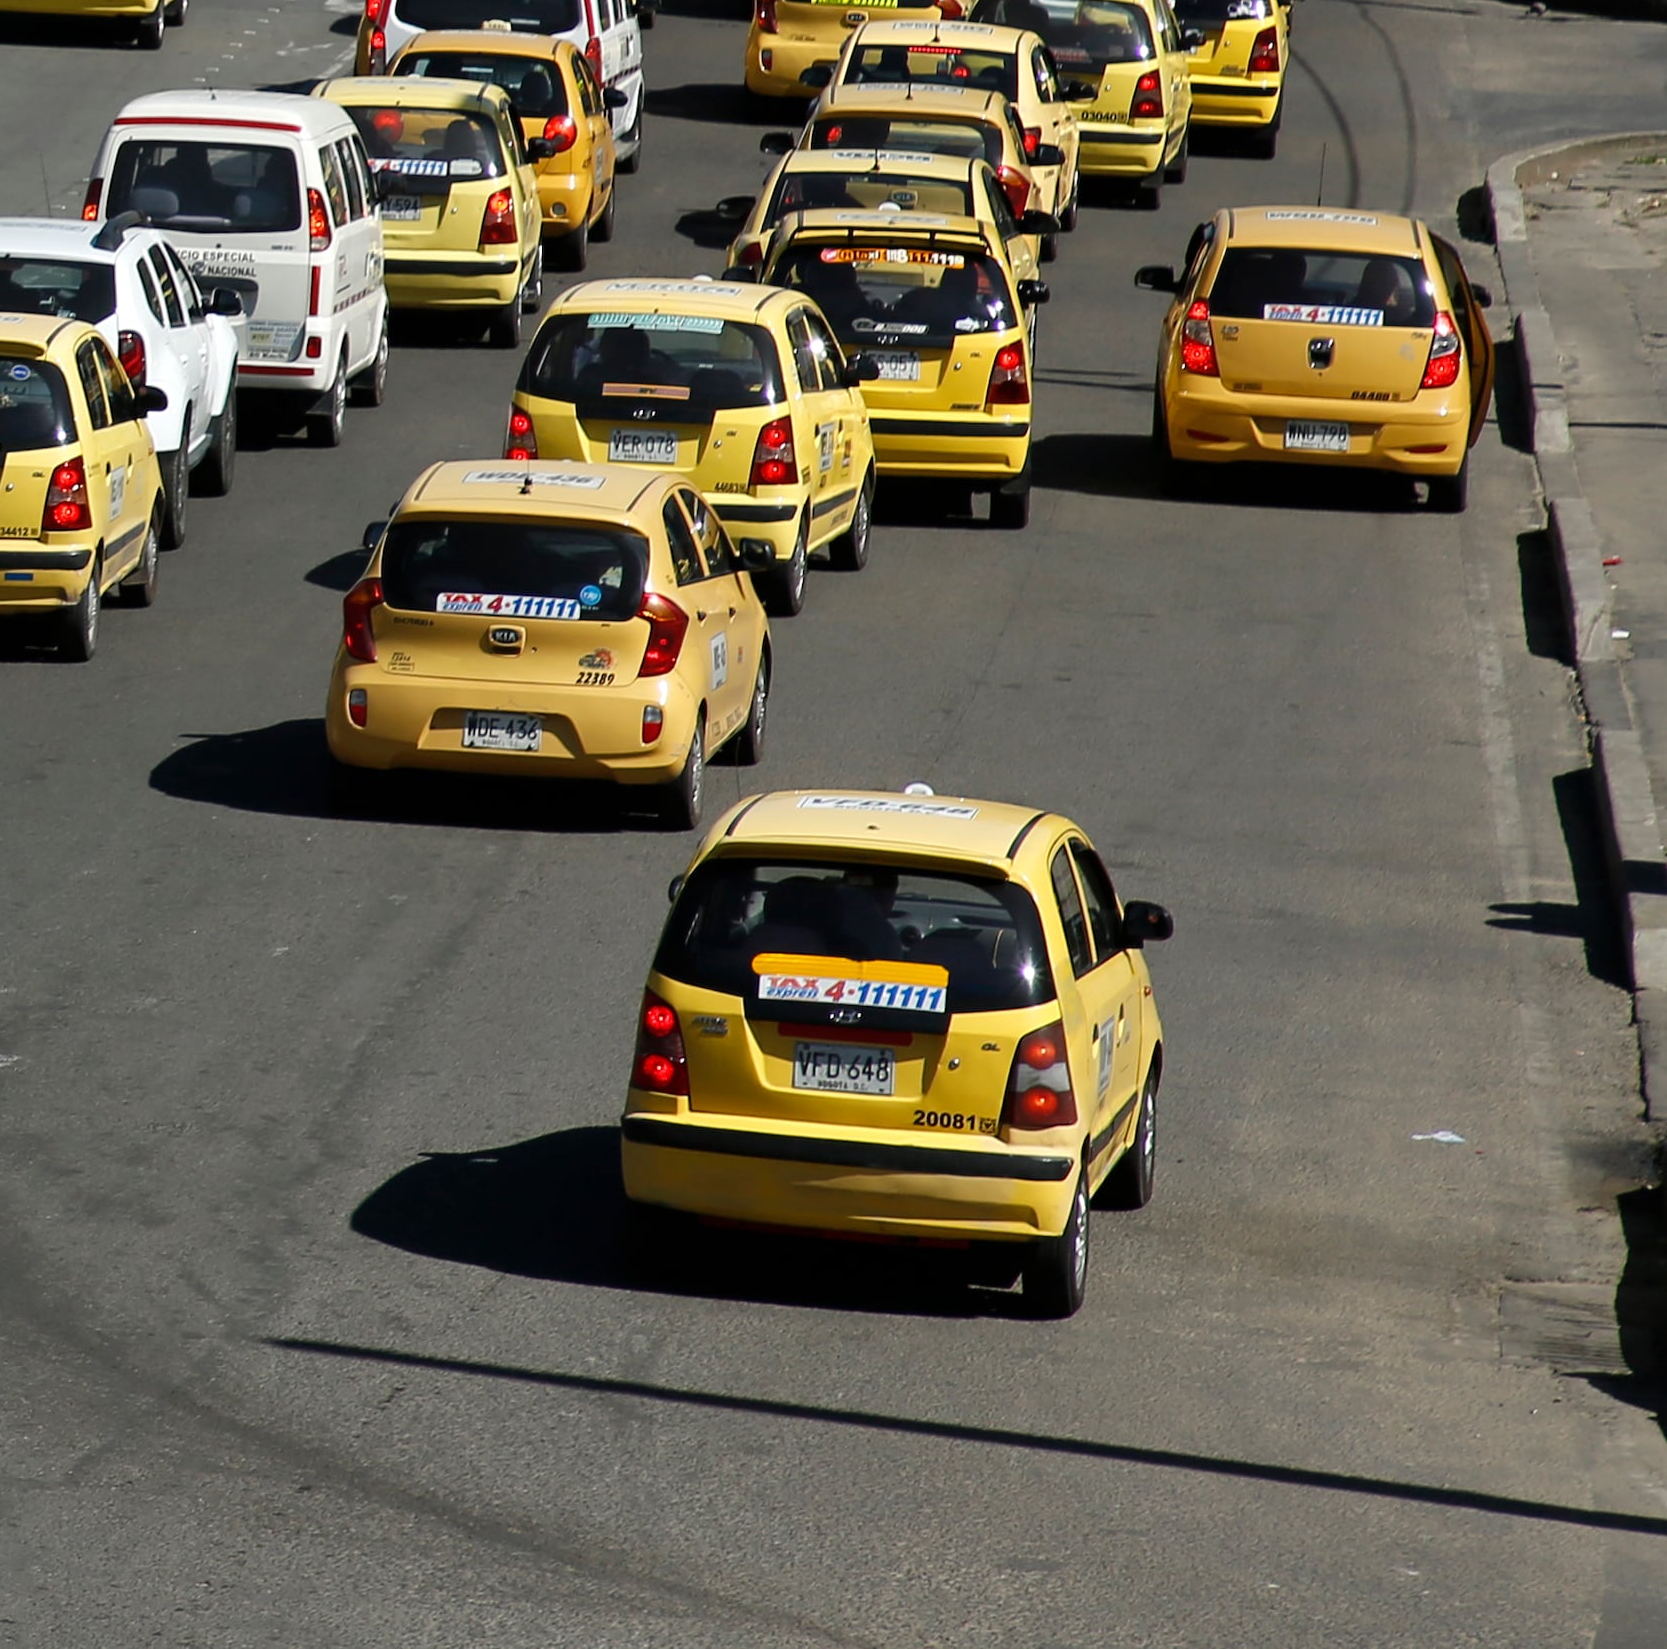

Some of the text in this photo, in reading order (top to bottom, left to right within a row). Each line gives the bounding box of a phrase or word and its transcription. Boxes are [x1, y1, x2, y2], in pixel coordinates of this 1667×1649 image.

[203, 251, 255, 262] ESPECIAL
[207, 264, 257, 277] NACIONAL
[494, 631, 517, 641] KIA
[575, 672, 615, 686] 22389
[797, 1050, 890, 1083] VFD 648
[912, 1109, 978, 1131] 20081
